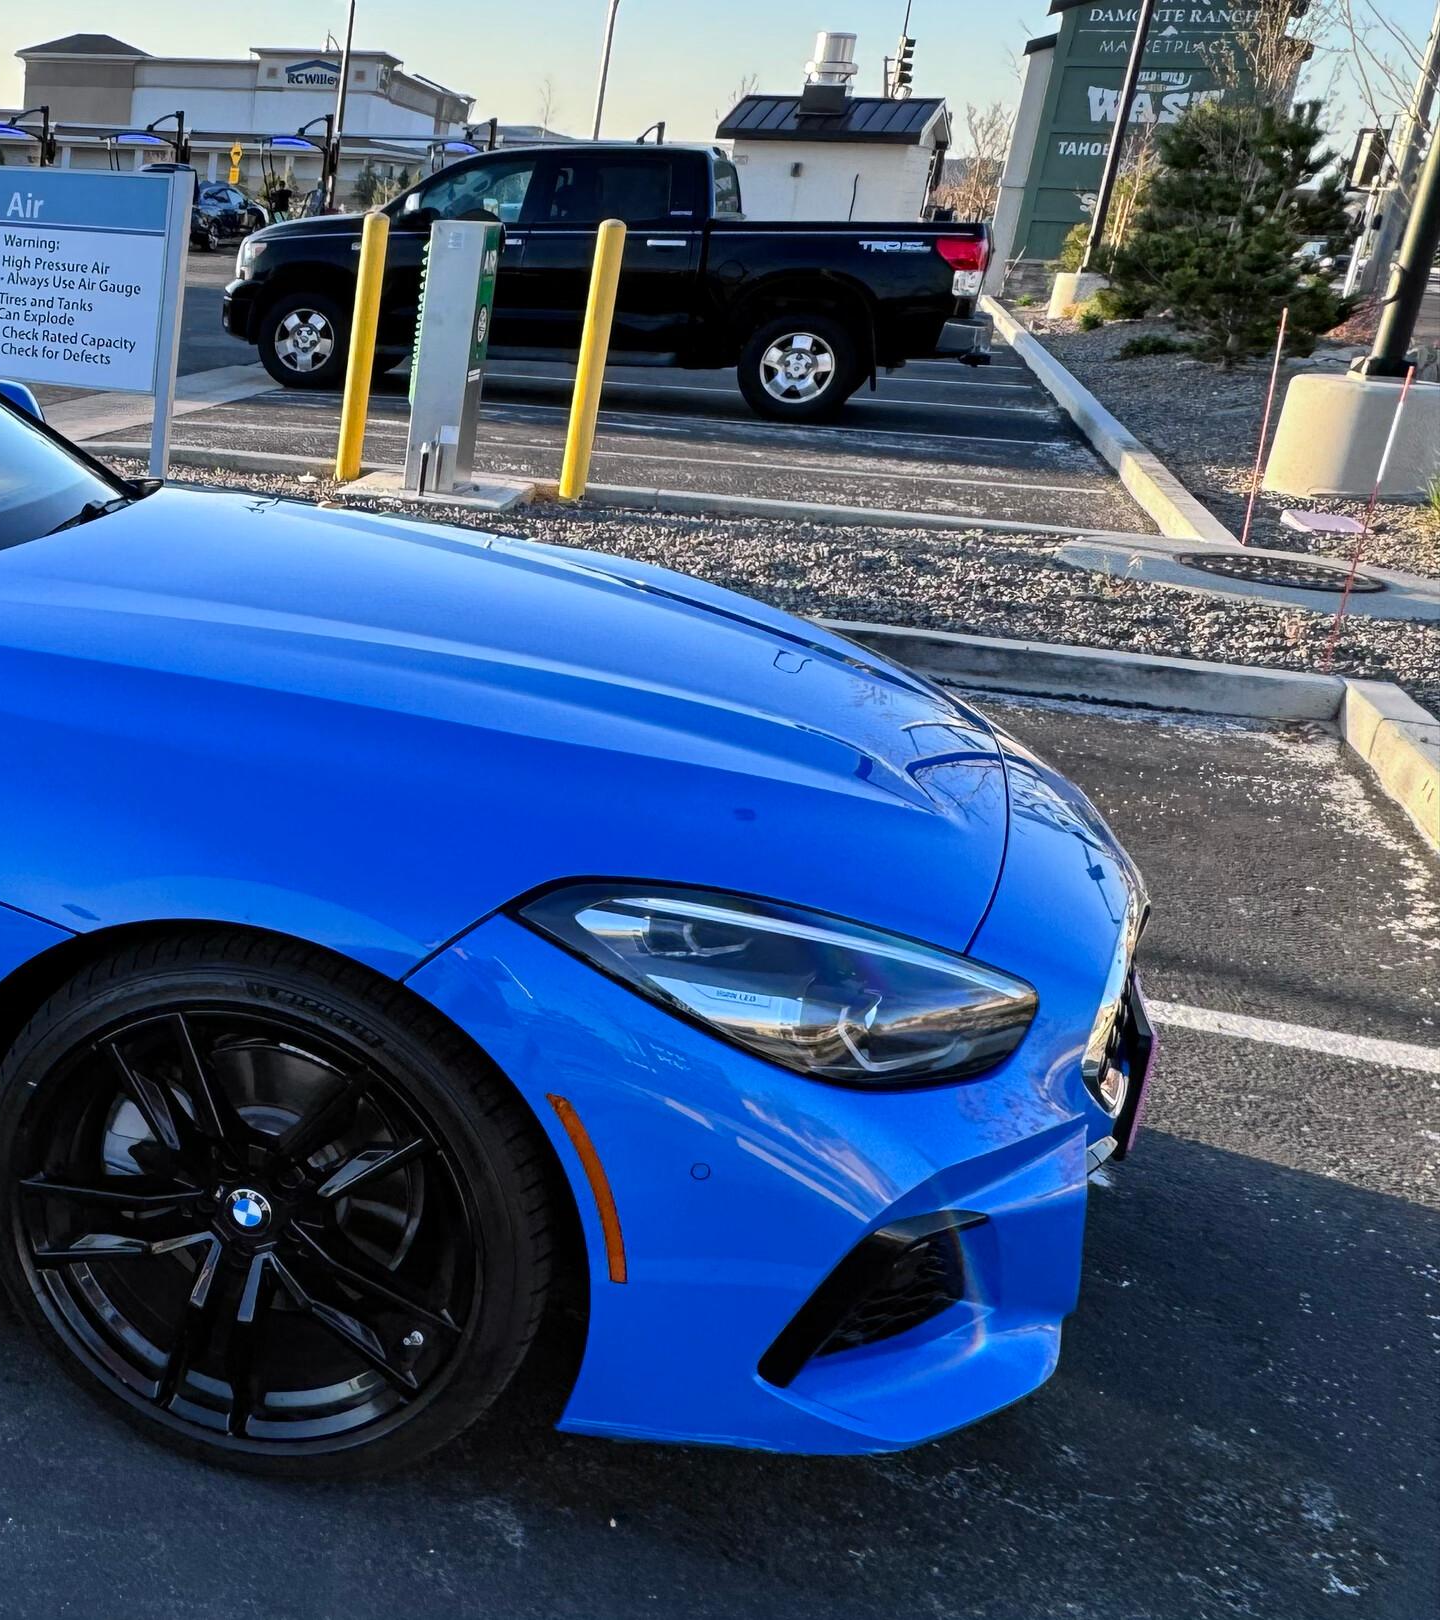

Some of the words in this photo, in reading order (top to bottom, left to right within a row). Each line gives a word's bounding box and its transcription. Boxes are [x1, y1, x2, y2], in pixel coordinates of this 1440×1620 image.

[1099, 39, 1232, 54] MAKETPLACE
[6, 191, 45, 219] Air
[3, 233, 61, 253] Warning:
[1, 255, 31, 271] High
[34, 257, 88, 274] Pressure
[91, 261, 111, 275] Air
[6, 271, 50, 290] Always
[52, 275, 76, 290] Use
[77, 277, 97, 291] Air
[99, 279, 142, 298] Gauge
[30, 296, 55, 309] and
[57, 297, 94, 312] Tanks
[23, 309, 76, 327] Explode
[2, 326, 39, 342] Check
[42, 329, 79, 345] Rated
[81, 333, 137, 354] Capacity
[0, 342, 39, 358] Check
[42, 345, 61, 360] for
[63, 348, 111, 366] Defects
